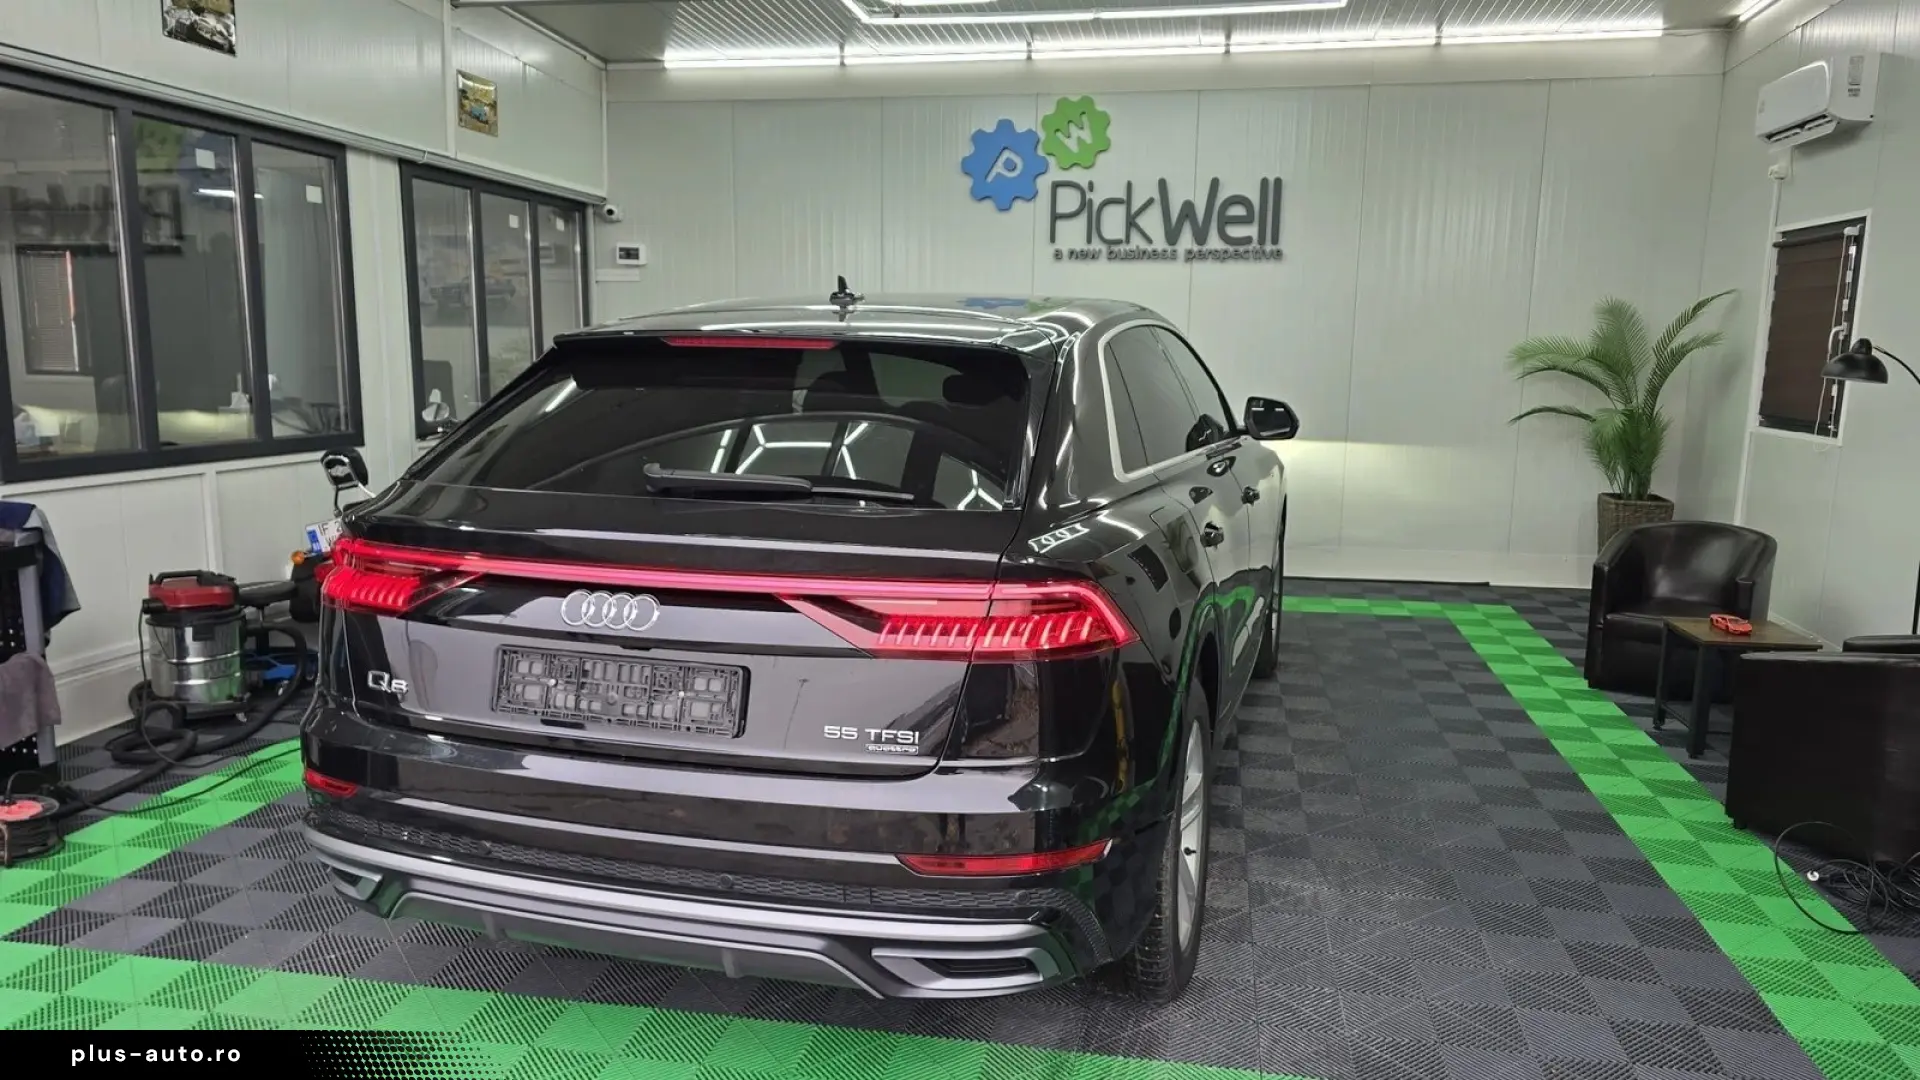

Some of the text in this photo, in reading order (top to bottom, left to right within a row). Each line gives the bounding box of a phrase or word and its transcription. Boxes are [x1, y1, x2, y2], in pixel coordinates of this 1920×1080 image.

[1054, 111, 1093, 153] W
[984, 147, 1023, 183] P
[1050, 177, 1283, 245] PickWell
[1053, 245, 1283, 263] a new business perspective
[368, 670, 408, 694] Q8
[823, 725, 919, 744] 55 TFSI
